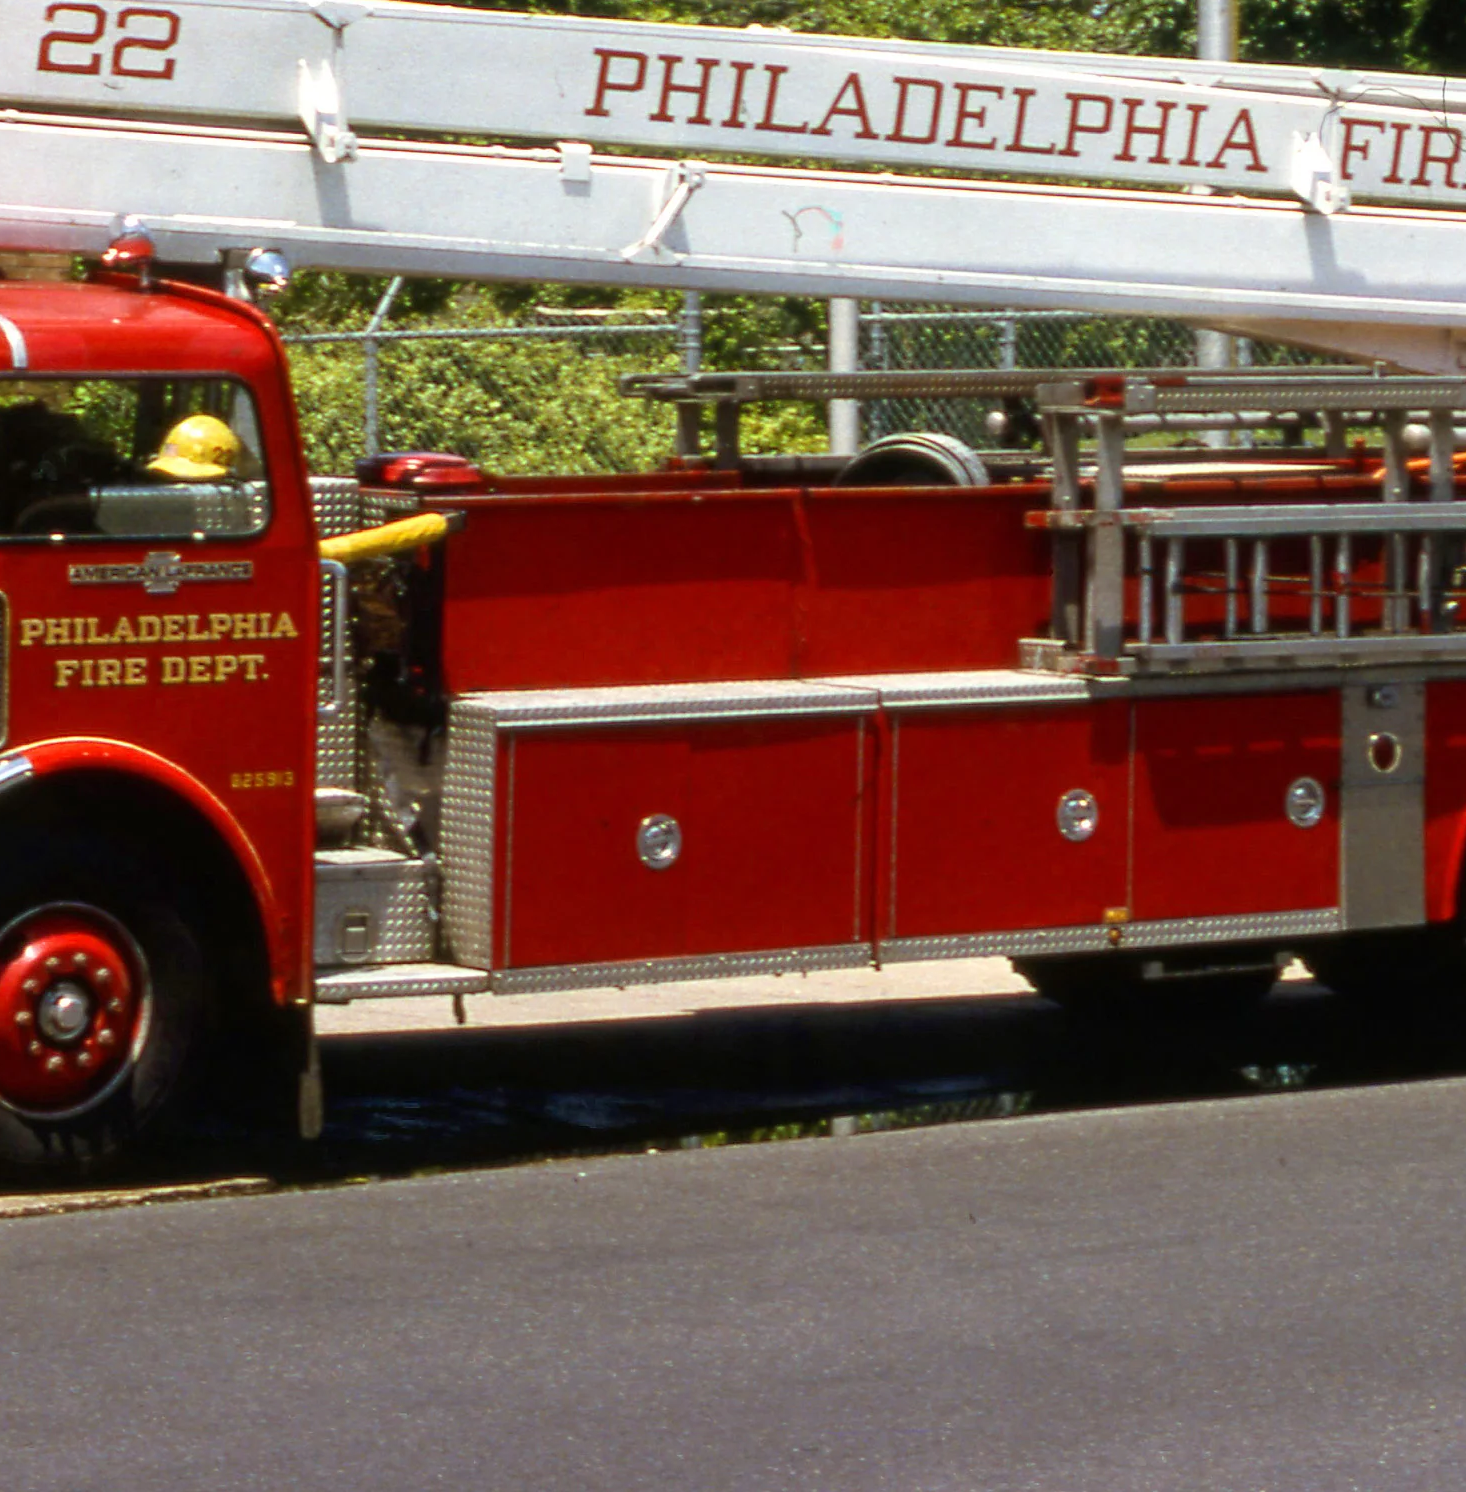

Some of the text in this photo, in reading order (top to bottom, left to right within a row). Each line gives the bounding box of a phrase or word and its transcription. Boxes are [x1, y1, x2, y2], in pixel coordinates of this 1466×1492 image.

[37, 2, 182, 80] 22
[585, 47, 1268, 173] PHILADELPHIA
[20, 612, 298, 646] PHILADELPHIA
[54, 654, 270, 687] FIRE DEPT.
